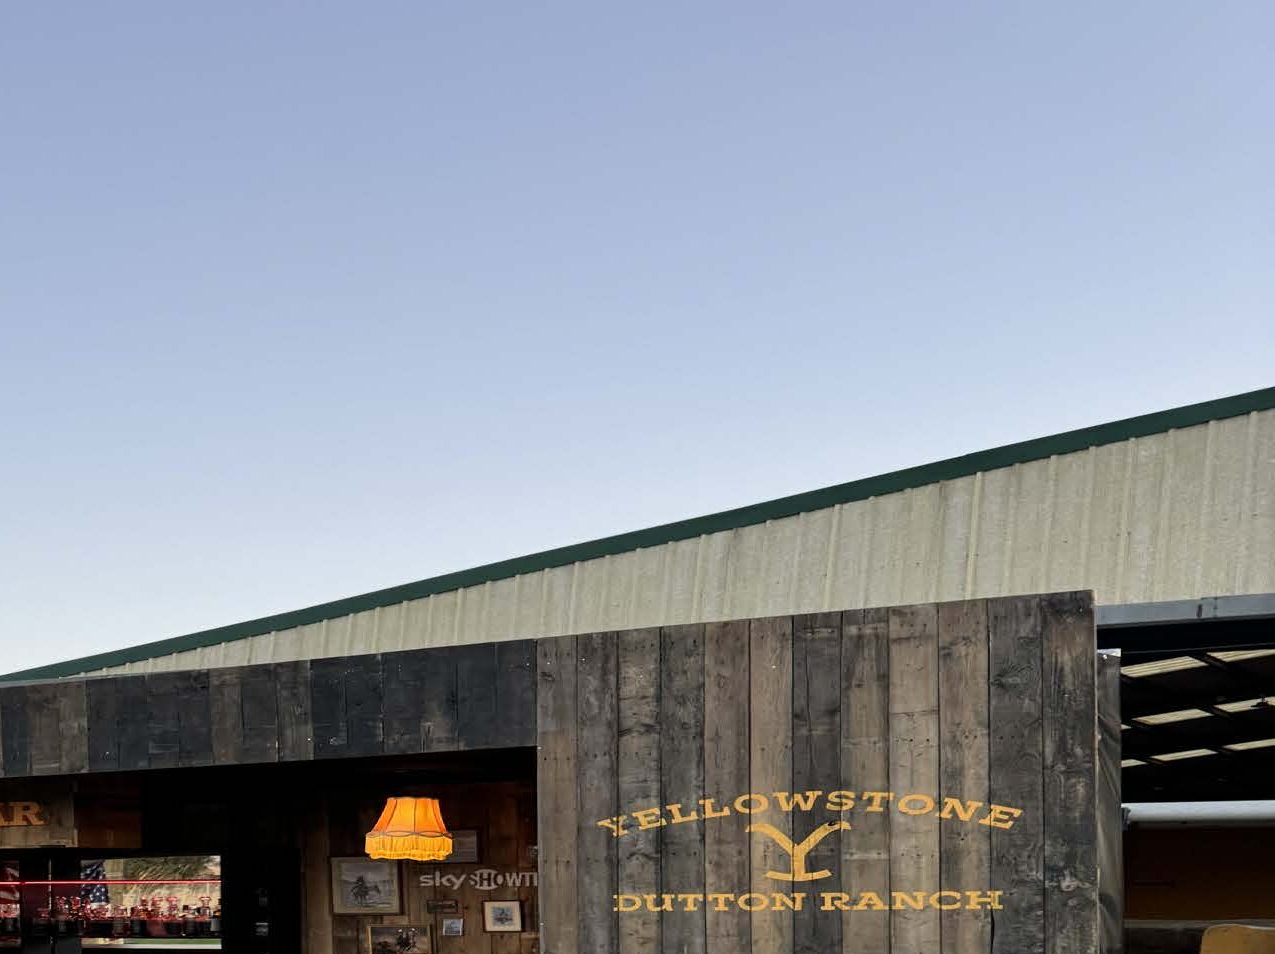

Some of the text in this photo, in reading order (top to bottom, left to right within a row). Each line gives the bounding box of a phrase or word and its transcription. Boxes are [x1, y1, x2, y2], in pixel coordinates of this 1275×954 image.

[596, 789, 1023, 838] YELLOWSTONE
[612, 889, 1005, 912] DUTTON RANCH
